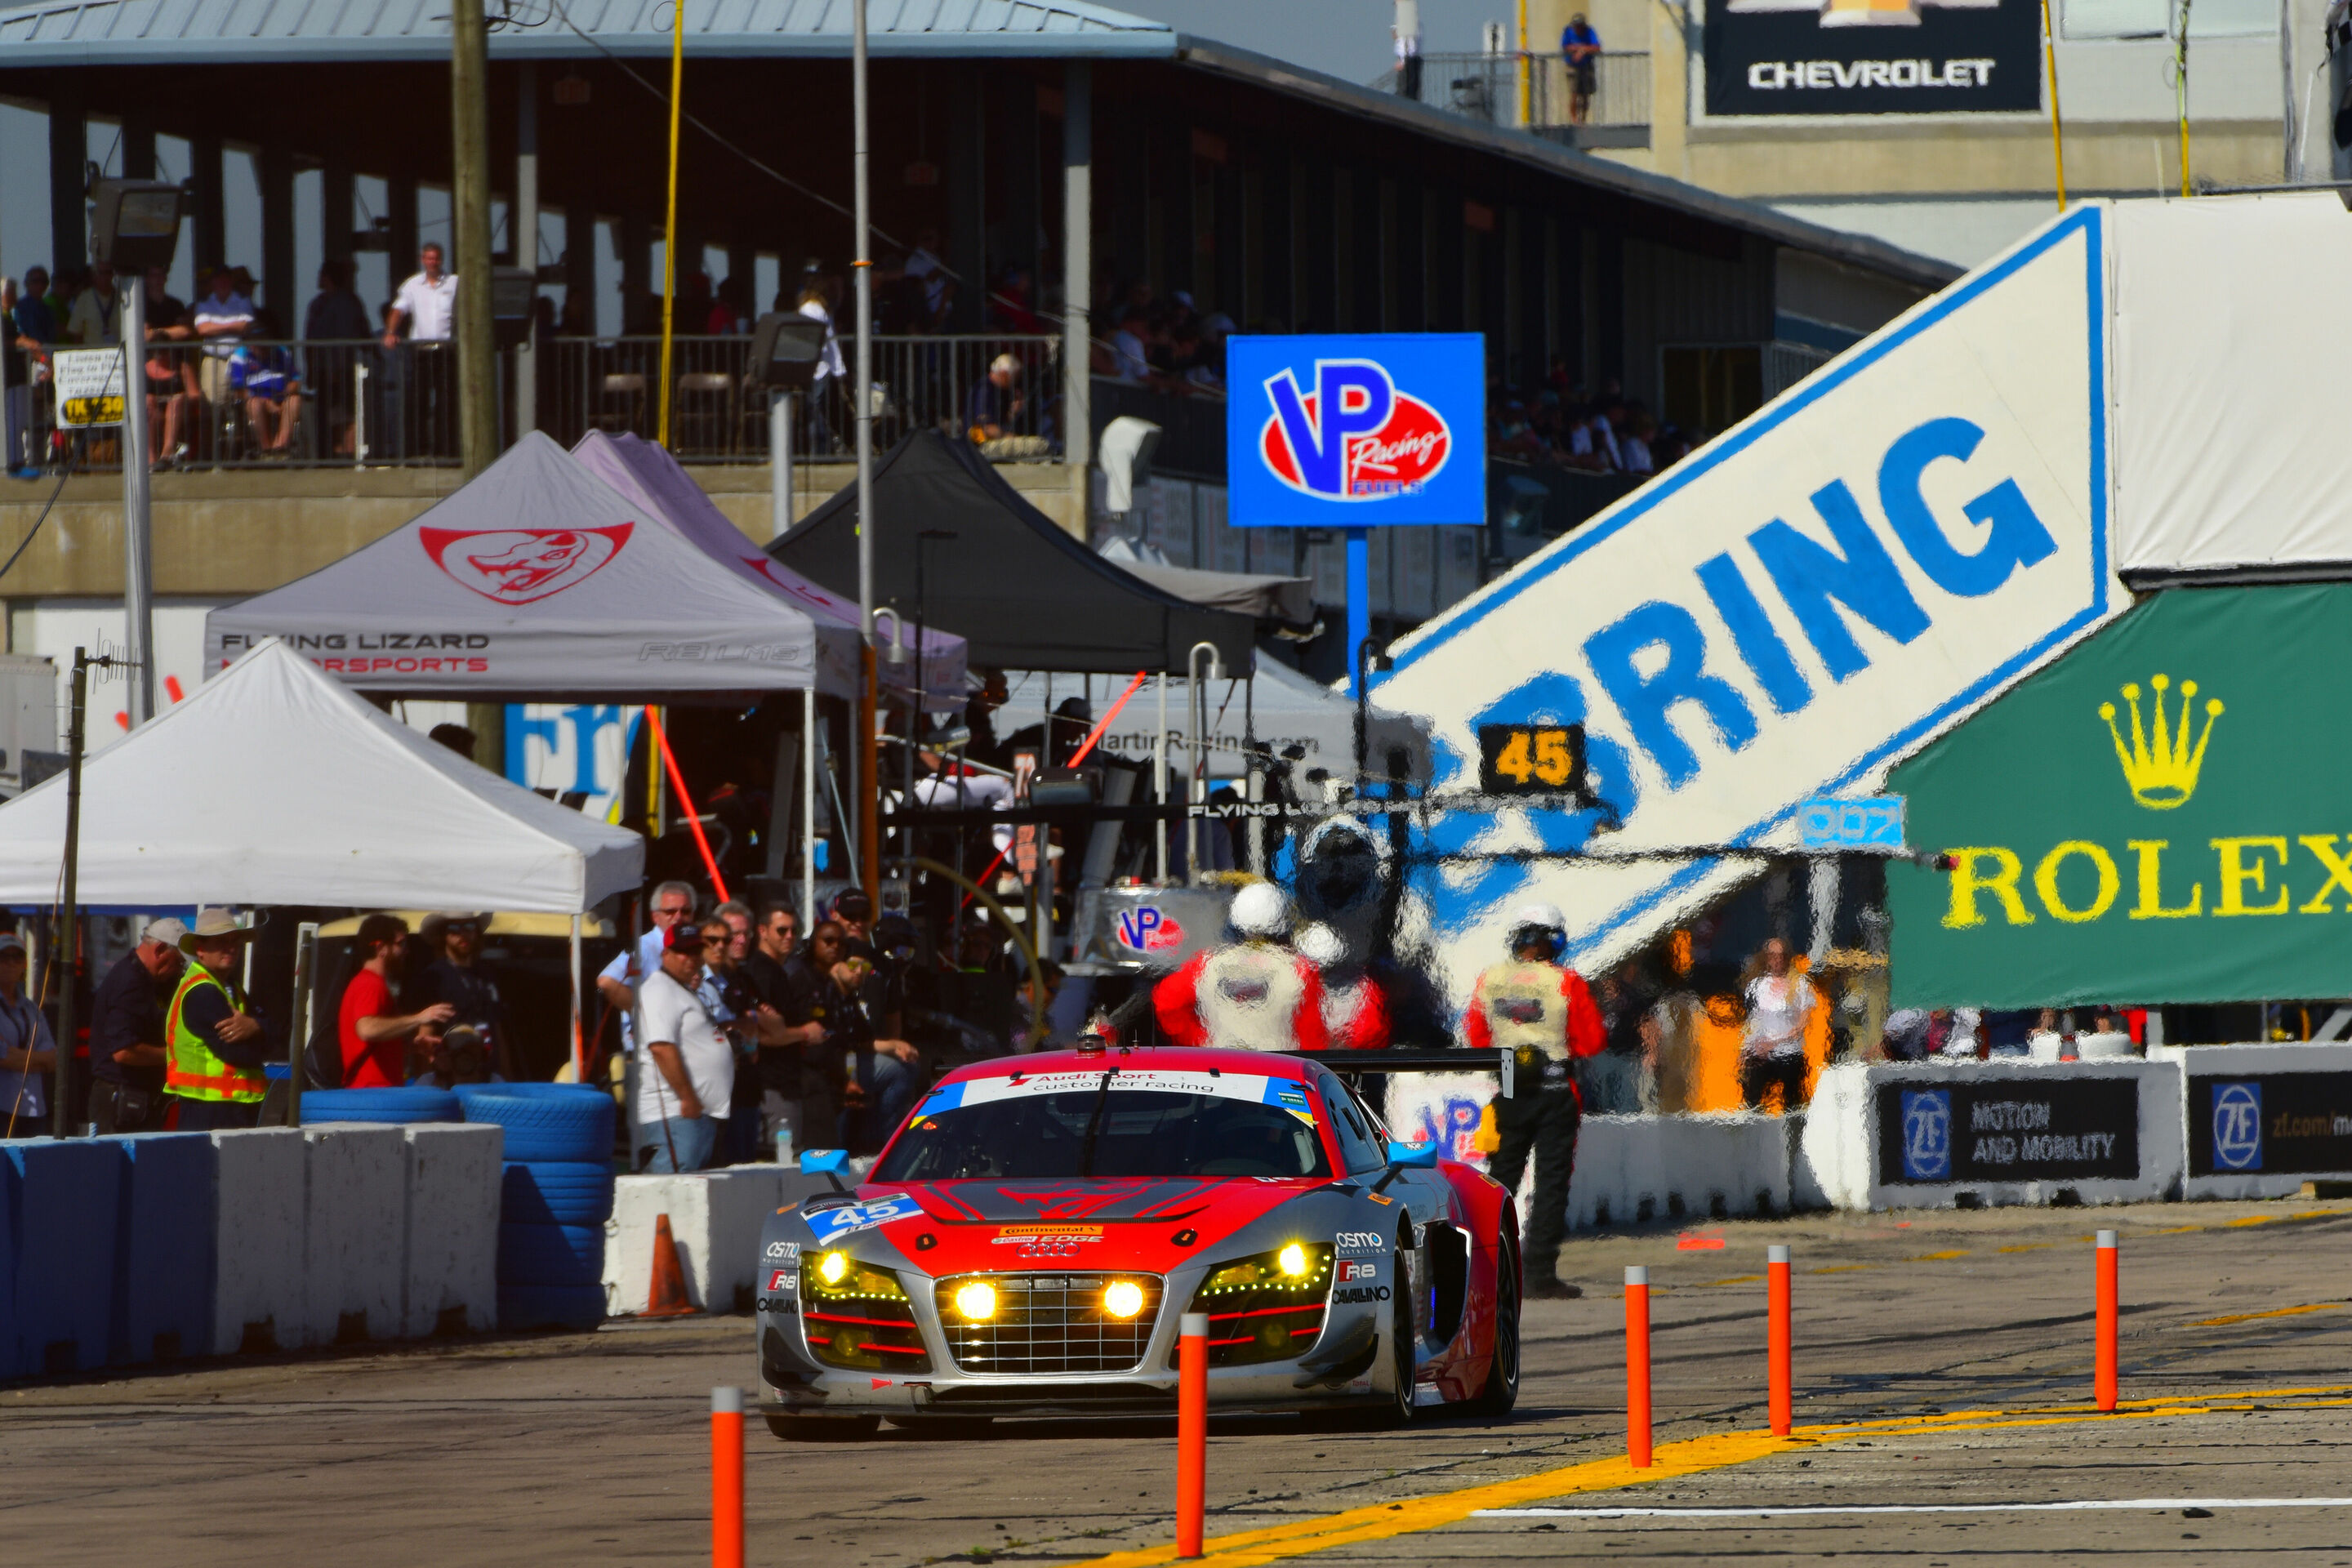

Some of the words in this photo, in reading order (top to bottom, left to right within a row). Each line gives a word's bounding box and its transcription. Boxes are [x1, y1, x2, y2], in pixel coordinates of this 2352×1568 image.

[1748, 59, 1996, 89] CHEVROLET
[1263, 359, 1395, 500] VP
[1352, 429, 1450, 479] Racing
[1352, 479, 1427, 497] FUELS
[221, 634, 347, 649] FLING
[359, 634, 490, 649] LIZARD
[714, 644, 798, 661] LMS
[1495, 730, 1574, 786] 45
[1188, 803, 1280, 817] FLYING
[1940, 833, 2352, 929] ROLEX
[1120, 906, 1160, 951] VP
[1036, 1073, 1088, 1083] Audi
[1145, 1082, 1214, 1094] racing
[1971, 1101, 2052, 1131] MOTION
[1421, 1098, 1483, 1160] VP
[1971, 1136, 2017, 1165] AND
[2020, 1132, 2116, 1162] MOBILITY
[831, 1201, 900, 1227] 45
[1004, 1227, 1085, 1235] Continental
[1040, 1235, 1105, 1243] EDGE
[1345, 1263, 1377, 1279] R8
[772, 1274, 798, 1290] R8
[1331, 1285, 1392, 1305] CAVALLINO
